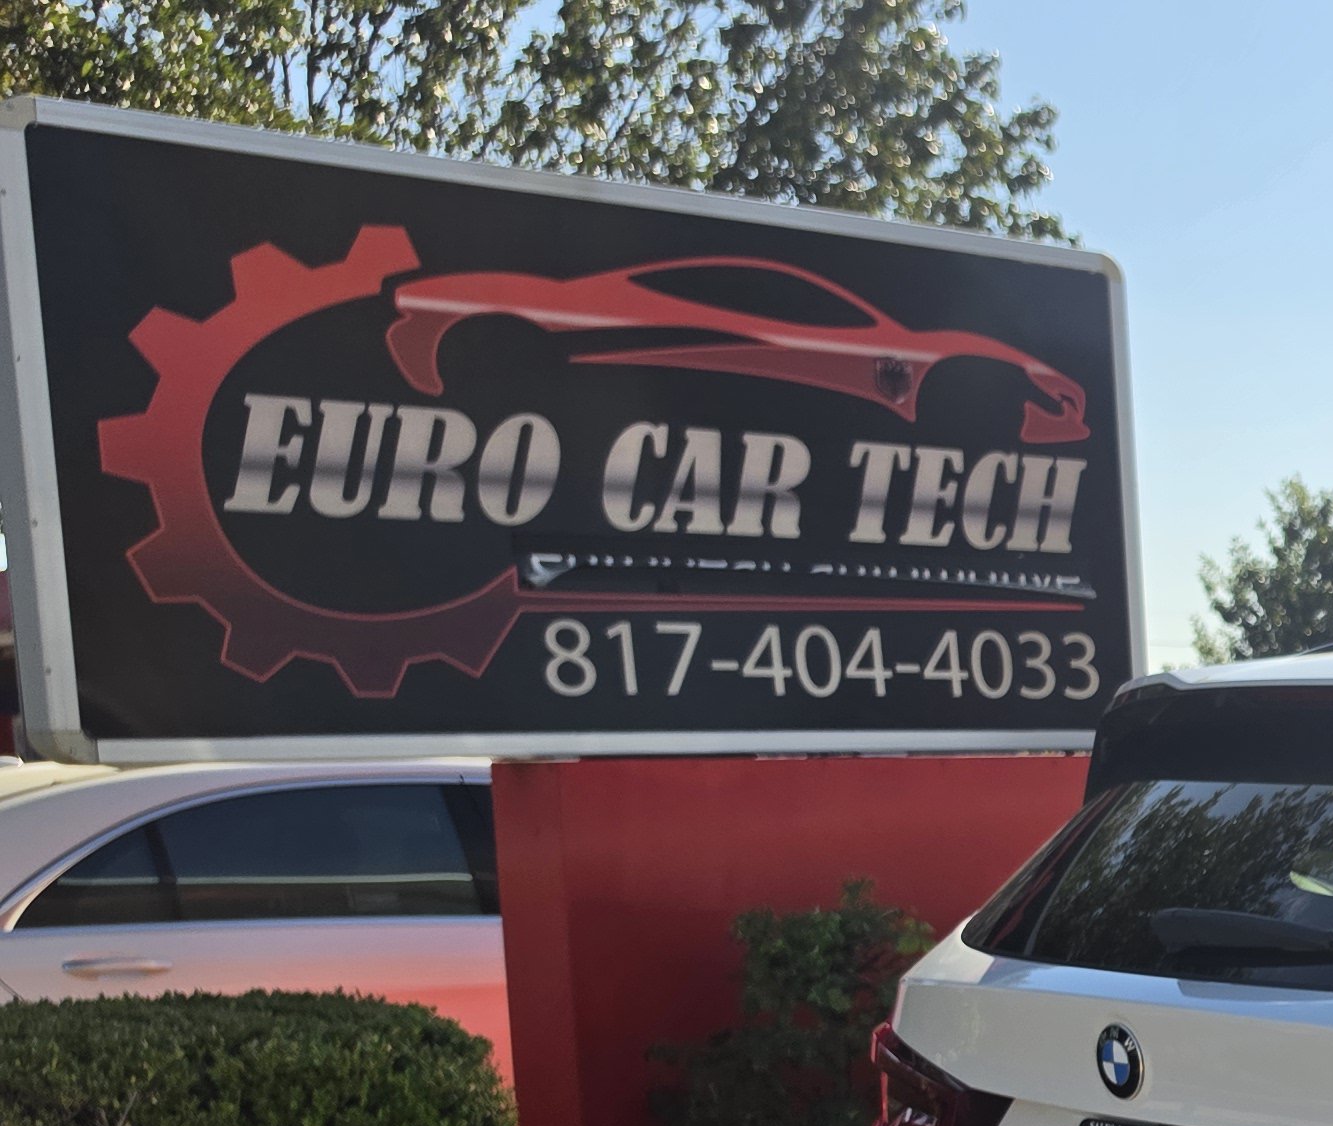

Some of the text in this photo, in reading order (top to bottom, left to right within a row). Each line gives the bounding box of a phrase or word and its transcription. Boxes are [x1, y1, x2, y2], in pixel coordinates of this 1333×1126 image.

[222, 392, 1089, 555] EURO CAR TECH
[543, 618, 1101, 701] 817-404-4033
